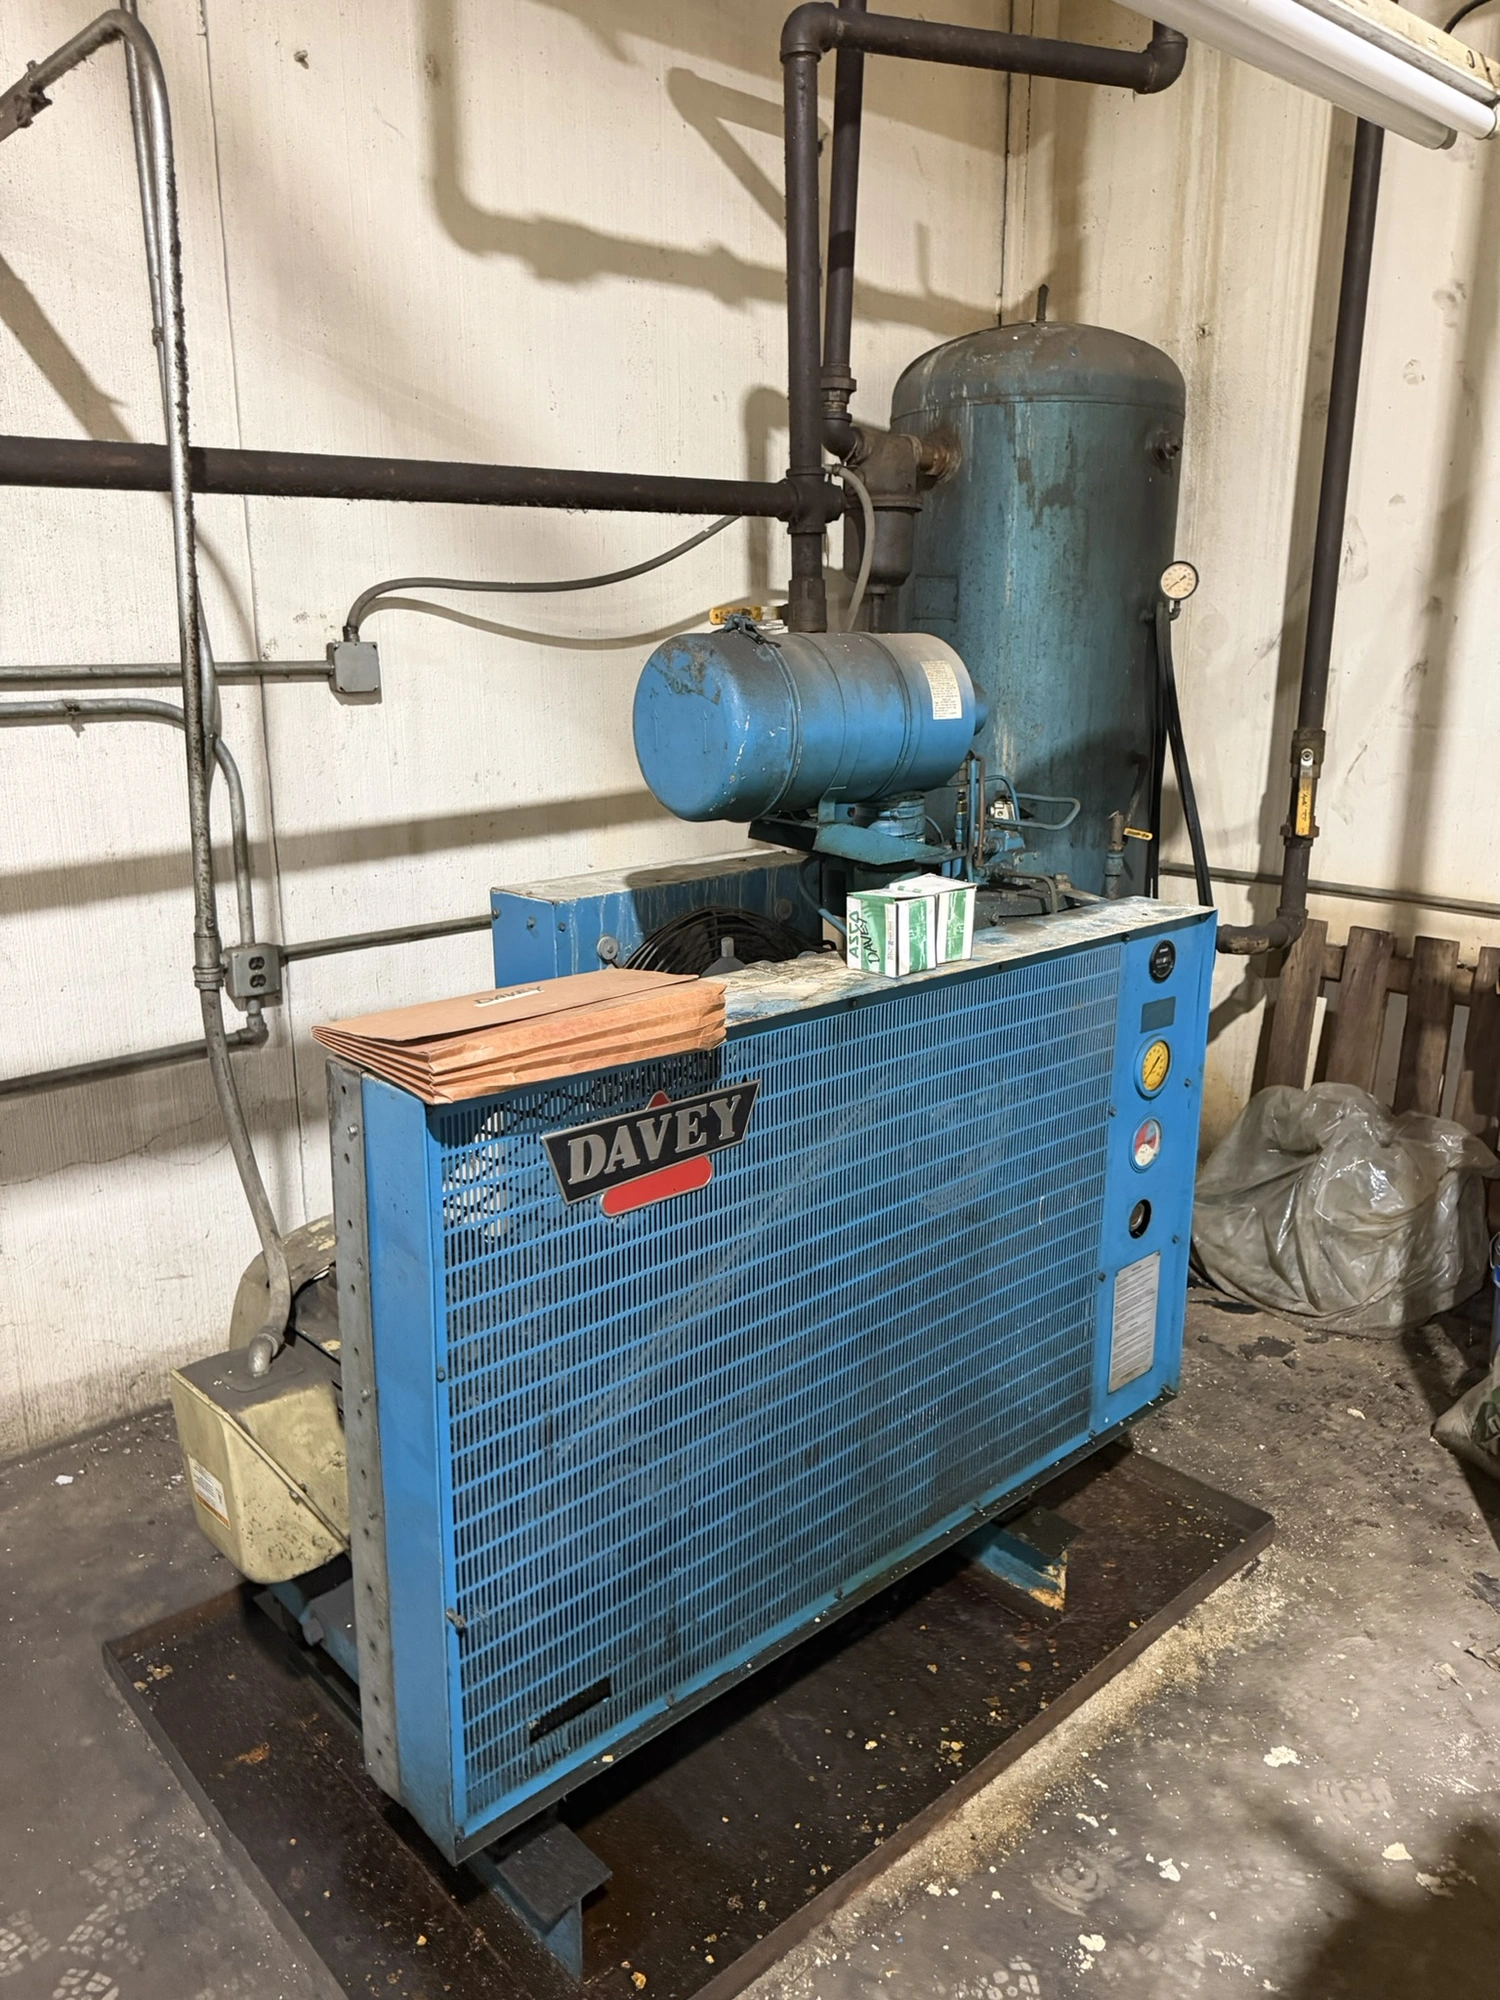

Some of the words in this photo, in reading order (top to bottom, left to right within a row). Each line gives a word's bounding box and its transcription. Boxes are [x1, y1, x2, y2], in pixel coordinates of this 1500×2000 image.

[849, 910, 861, 959] ASCO
[857, 916, 881, 965] DAVEY
[473, 986, 542, 1004] DAVEY
[568, 1096, 742, 1185] DAVEY
